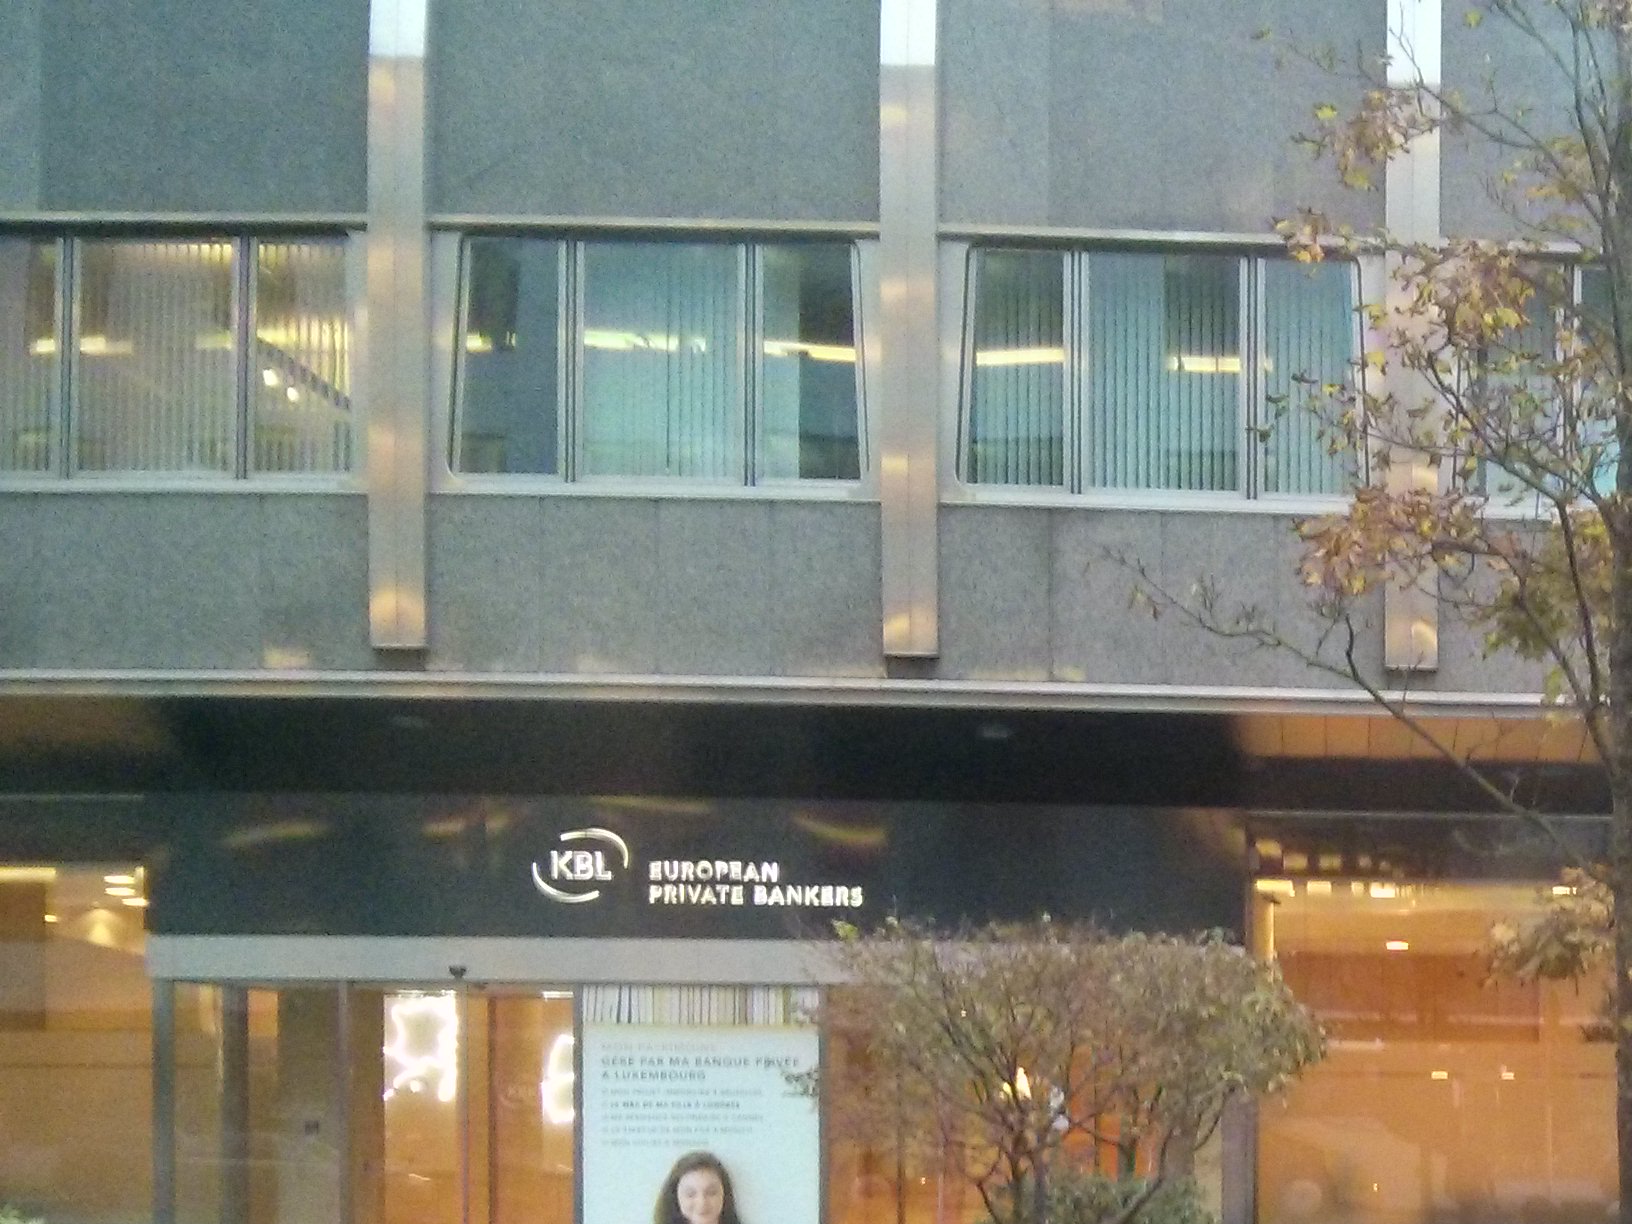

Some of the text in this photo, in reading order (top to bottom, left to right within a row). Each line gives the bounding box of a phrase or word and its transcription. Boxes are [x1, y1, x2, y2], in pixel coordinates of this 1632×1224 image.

[550, 849, 612, 881] KBL
[649, 860, 779, 883] EUROPEAN
[648, 884, 863, 907] PRIVATE BANKERS
